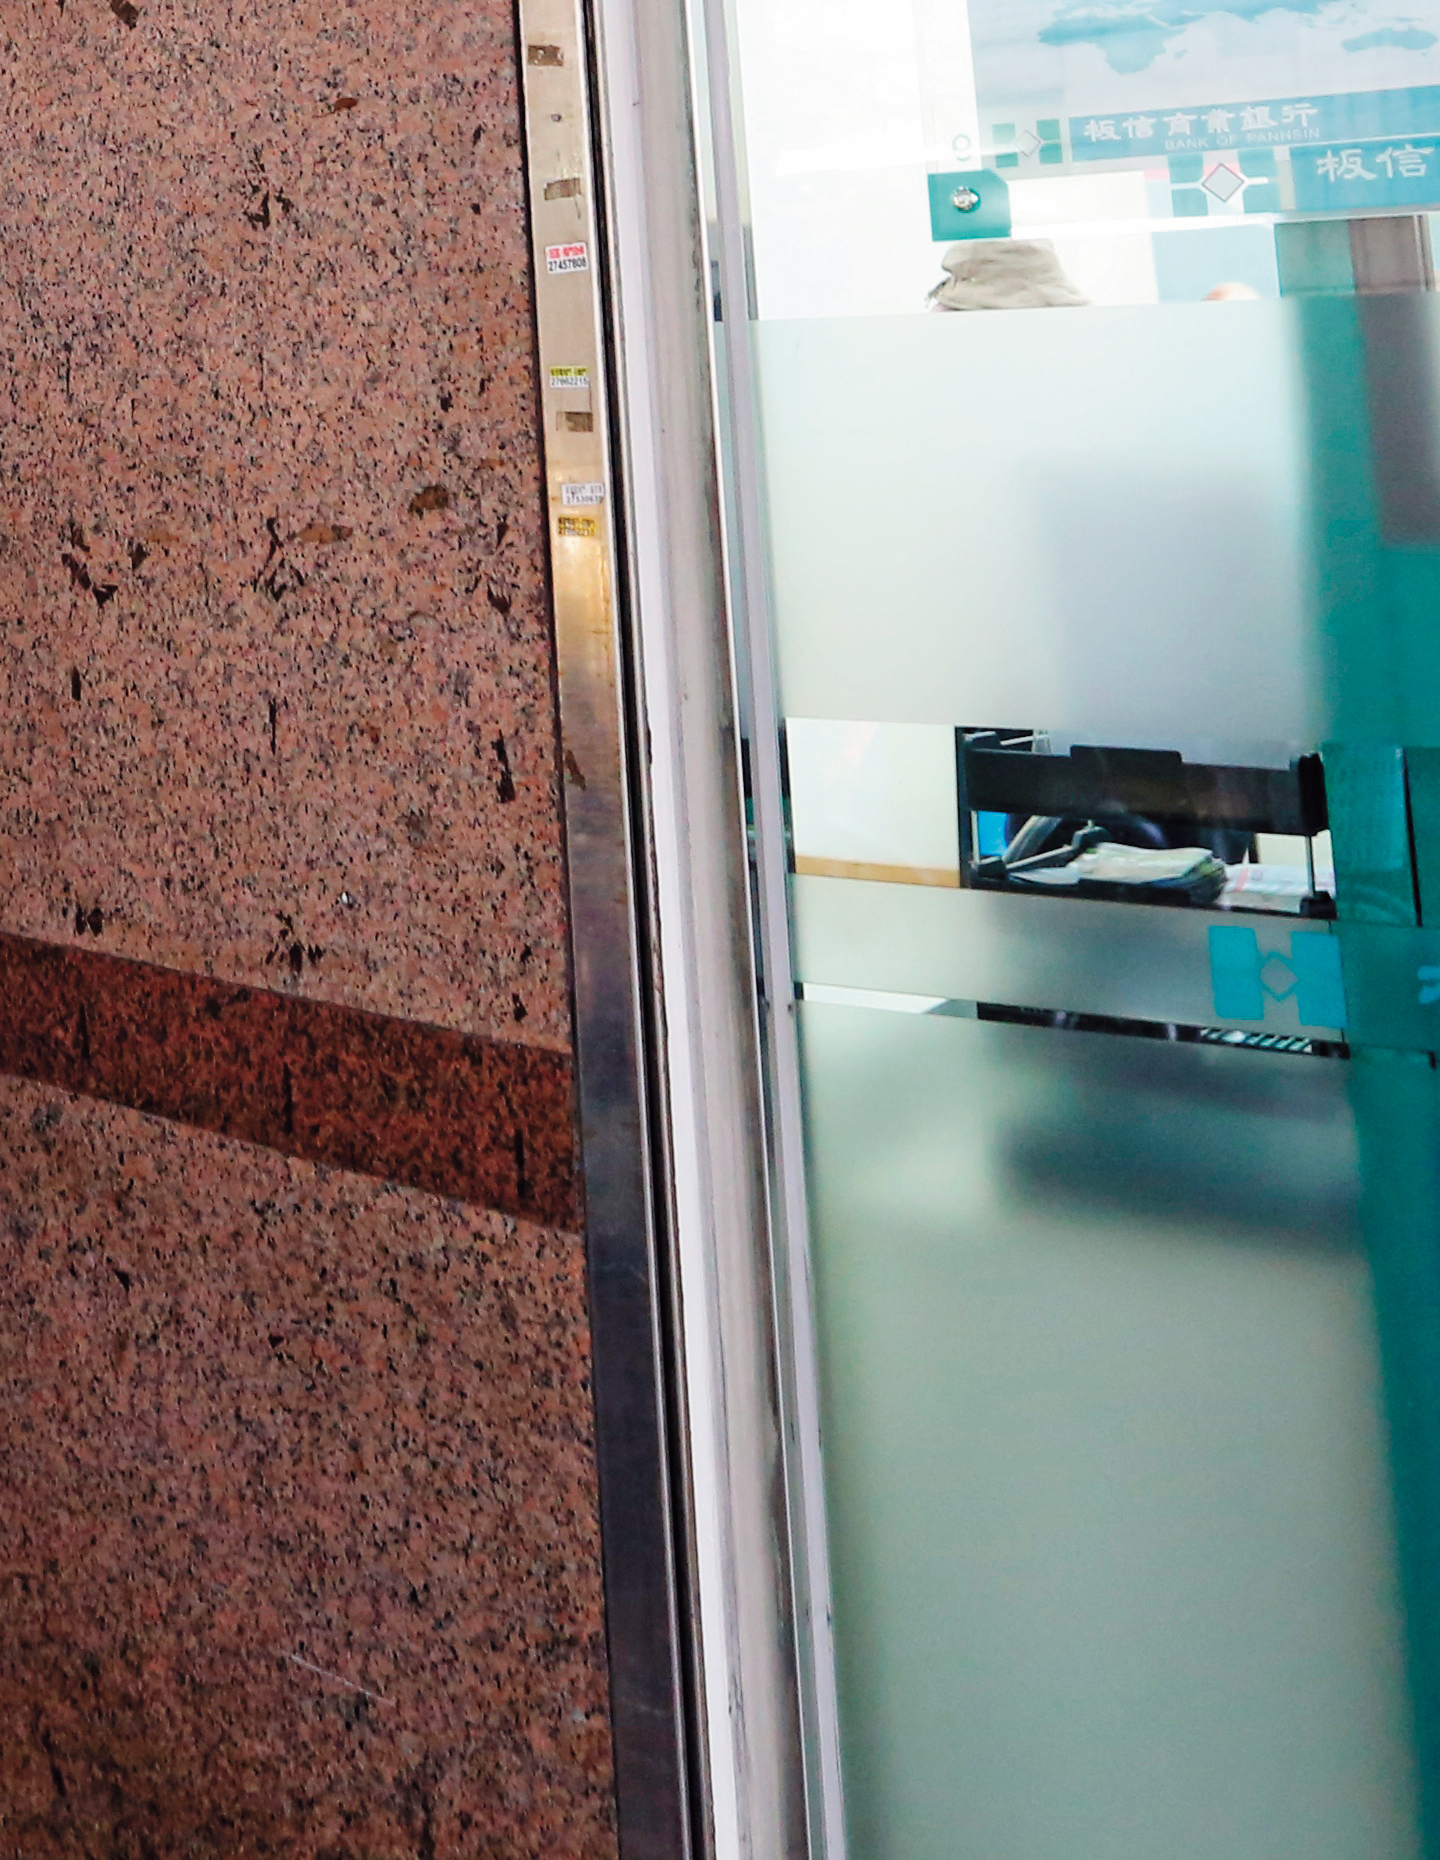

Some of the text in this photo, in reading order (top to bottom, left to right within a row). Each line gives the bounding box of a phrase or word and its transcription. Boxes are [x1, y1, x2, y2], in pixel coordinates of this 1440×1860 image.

[1083, 103, 1318, 143] 板信商業銀行
[1165, 136, 1208, 150] BANK
